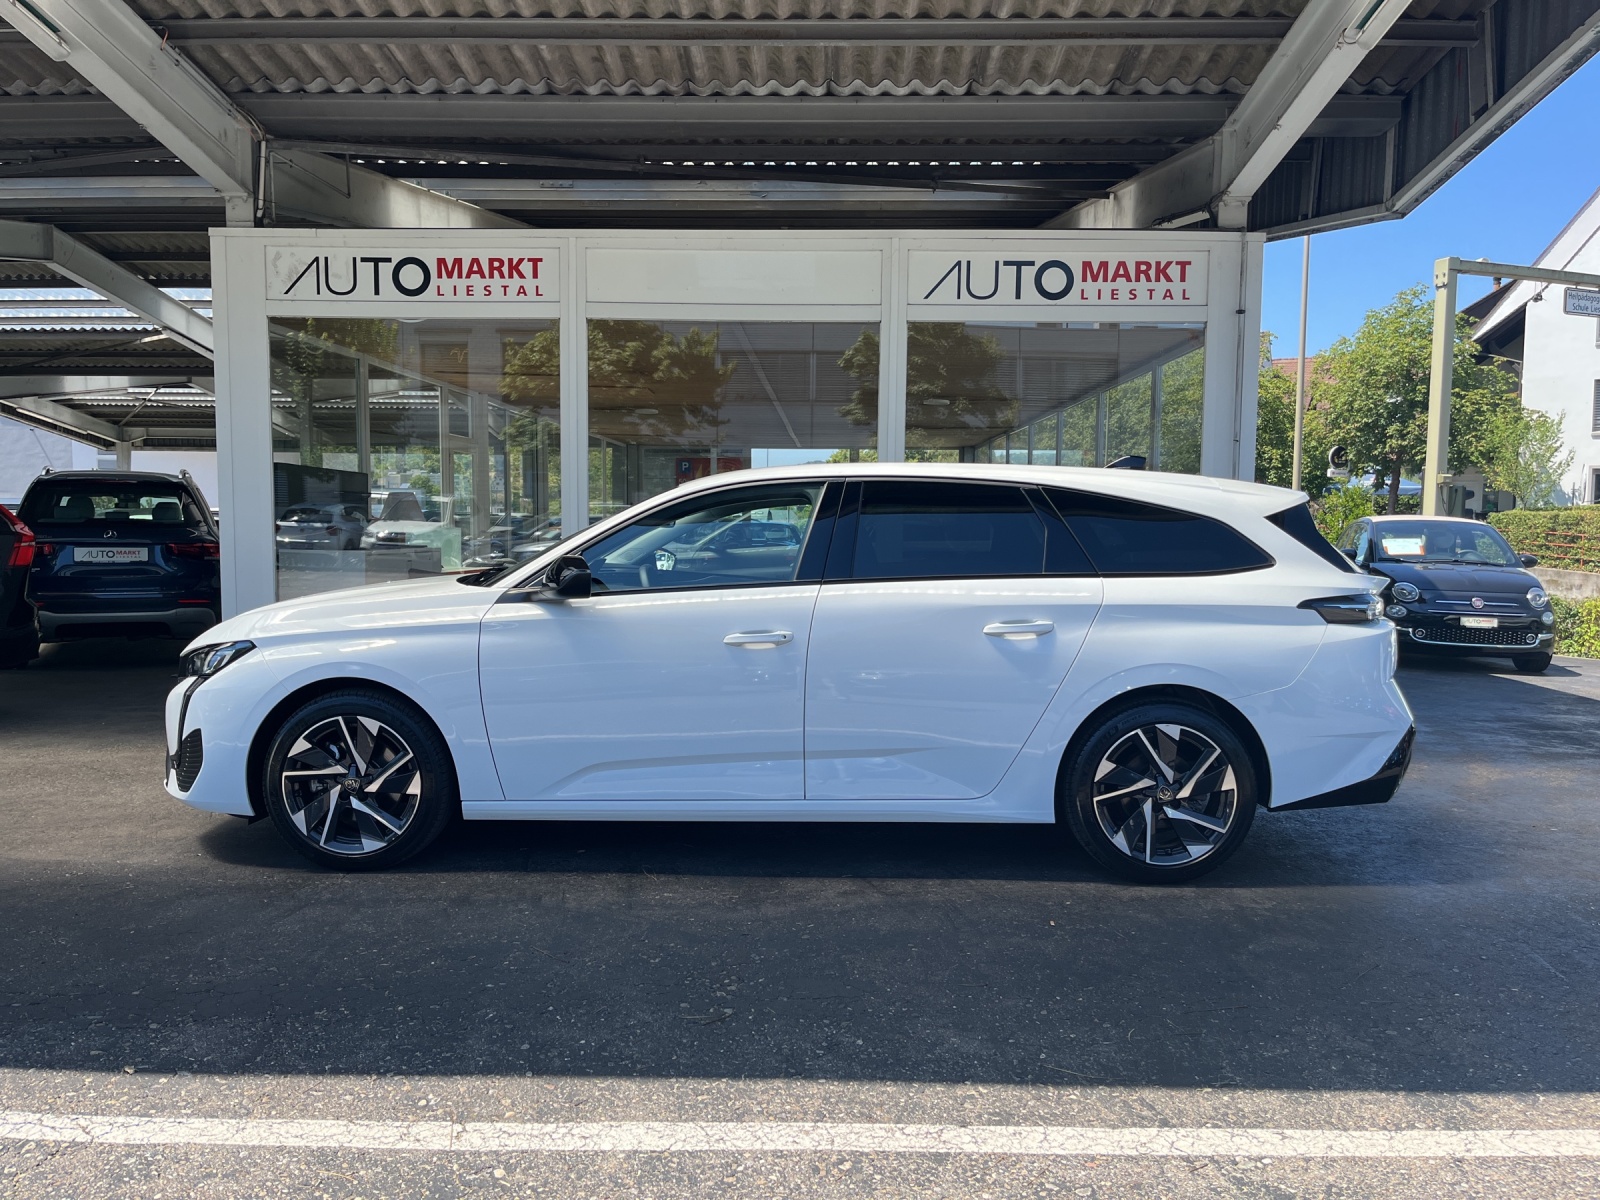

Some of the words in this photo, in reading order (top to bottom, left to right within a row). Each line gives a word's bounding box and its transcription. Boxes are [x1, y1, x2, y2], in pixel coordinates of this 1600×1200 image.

[283, 256, 431, 297] AUTO
[436, 257, 543, 279] MARKT
[923, 260, 1074, 300] AUTO
[1081, 260, 1192, 283] MARKT
[436, 285, 543, 297] LIESTAL
[1080, 288, 1190, 300] LIESTAL
[1572, 303, 1589, 312] Schule
[682, 462, 689, 471] P
[81, 550, 115, 558] AUTO
